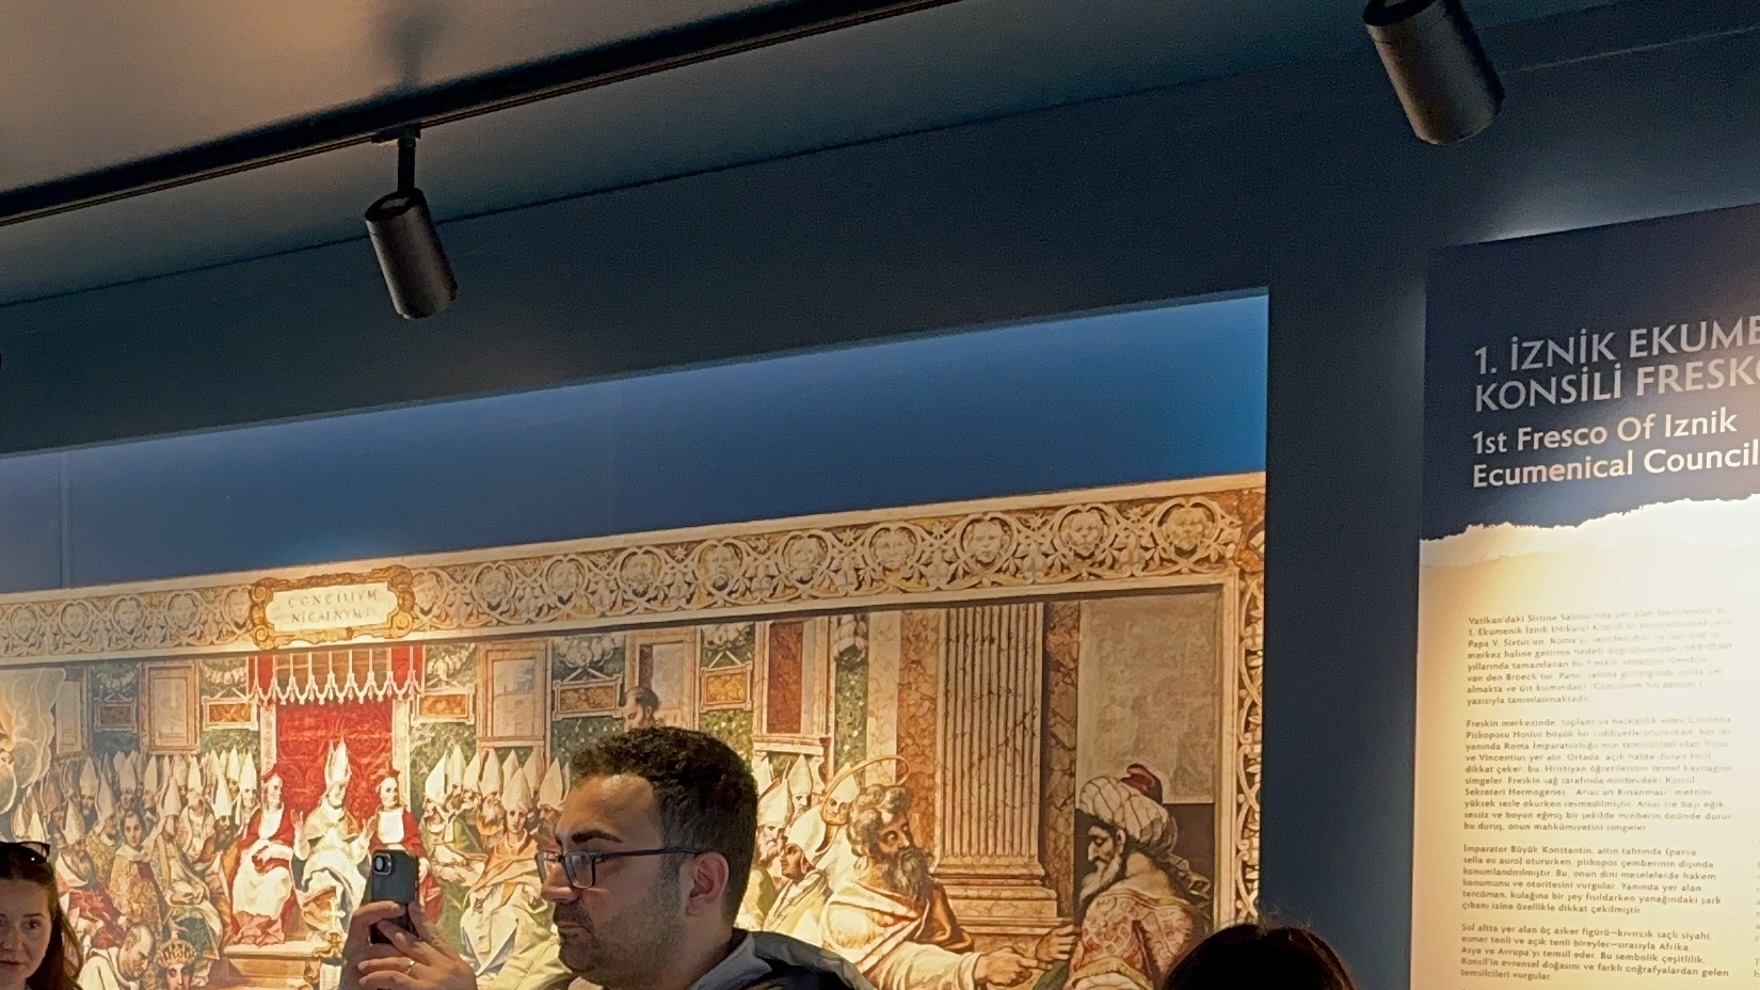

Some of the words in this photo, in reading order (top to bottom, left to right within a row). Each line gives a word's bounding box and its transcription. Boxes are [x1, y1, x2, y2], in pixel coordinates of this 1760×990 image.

[1474, 346, 1496, 374] 1.
[1511, 328, 1616, 371] İZNİK
[1475, 362, 1622, 412] KONSİLİ
[1636, 356, 1760, 396] FRESK
[1472, 431, 1507, 454] 1st
[1518, 426, 1608, 451] Fresco
[1618, 414, 1656, 442] Of
[1665, 406, 1738, 438] Iznik
[1472, 450, 1633, 488] Ecumenical
[1644, 438, 1760, 474] Council
